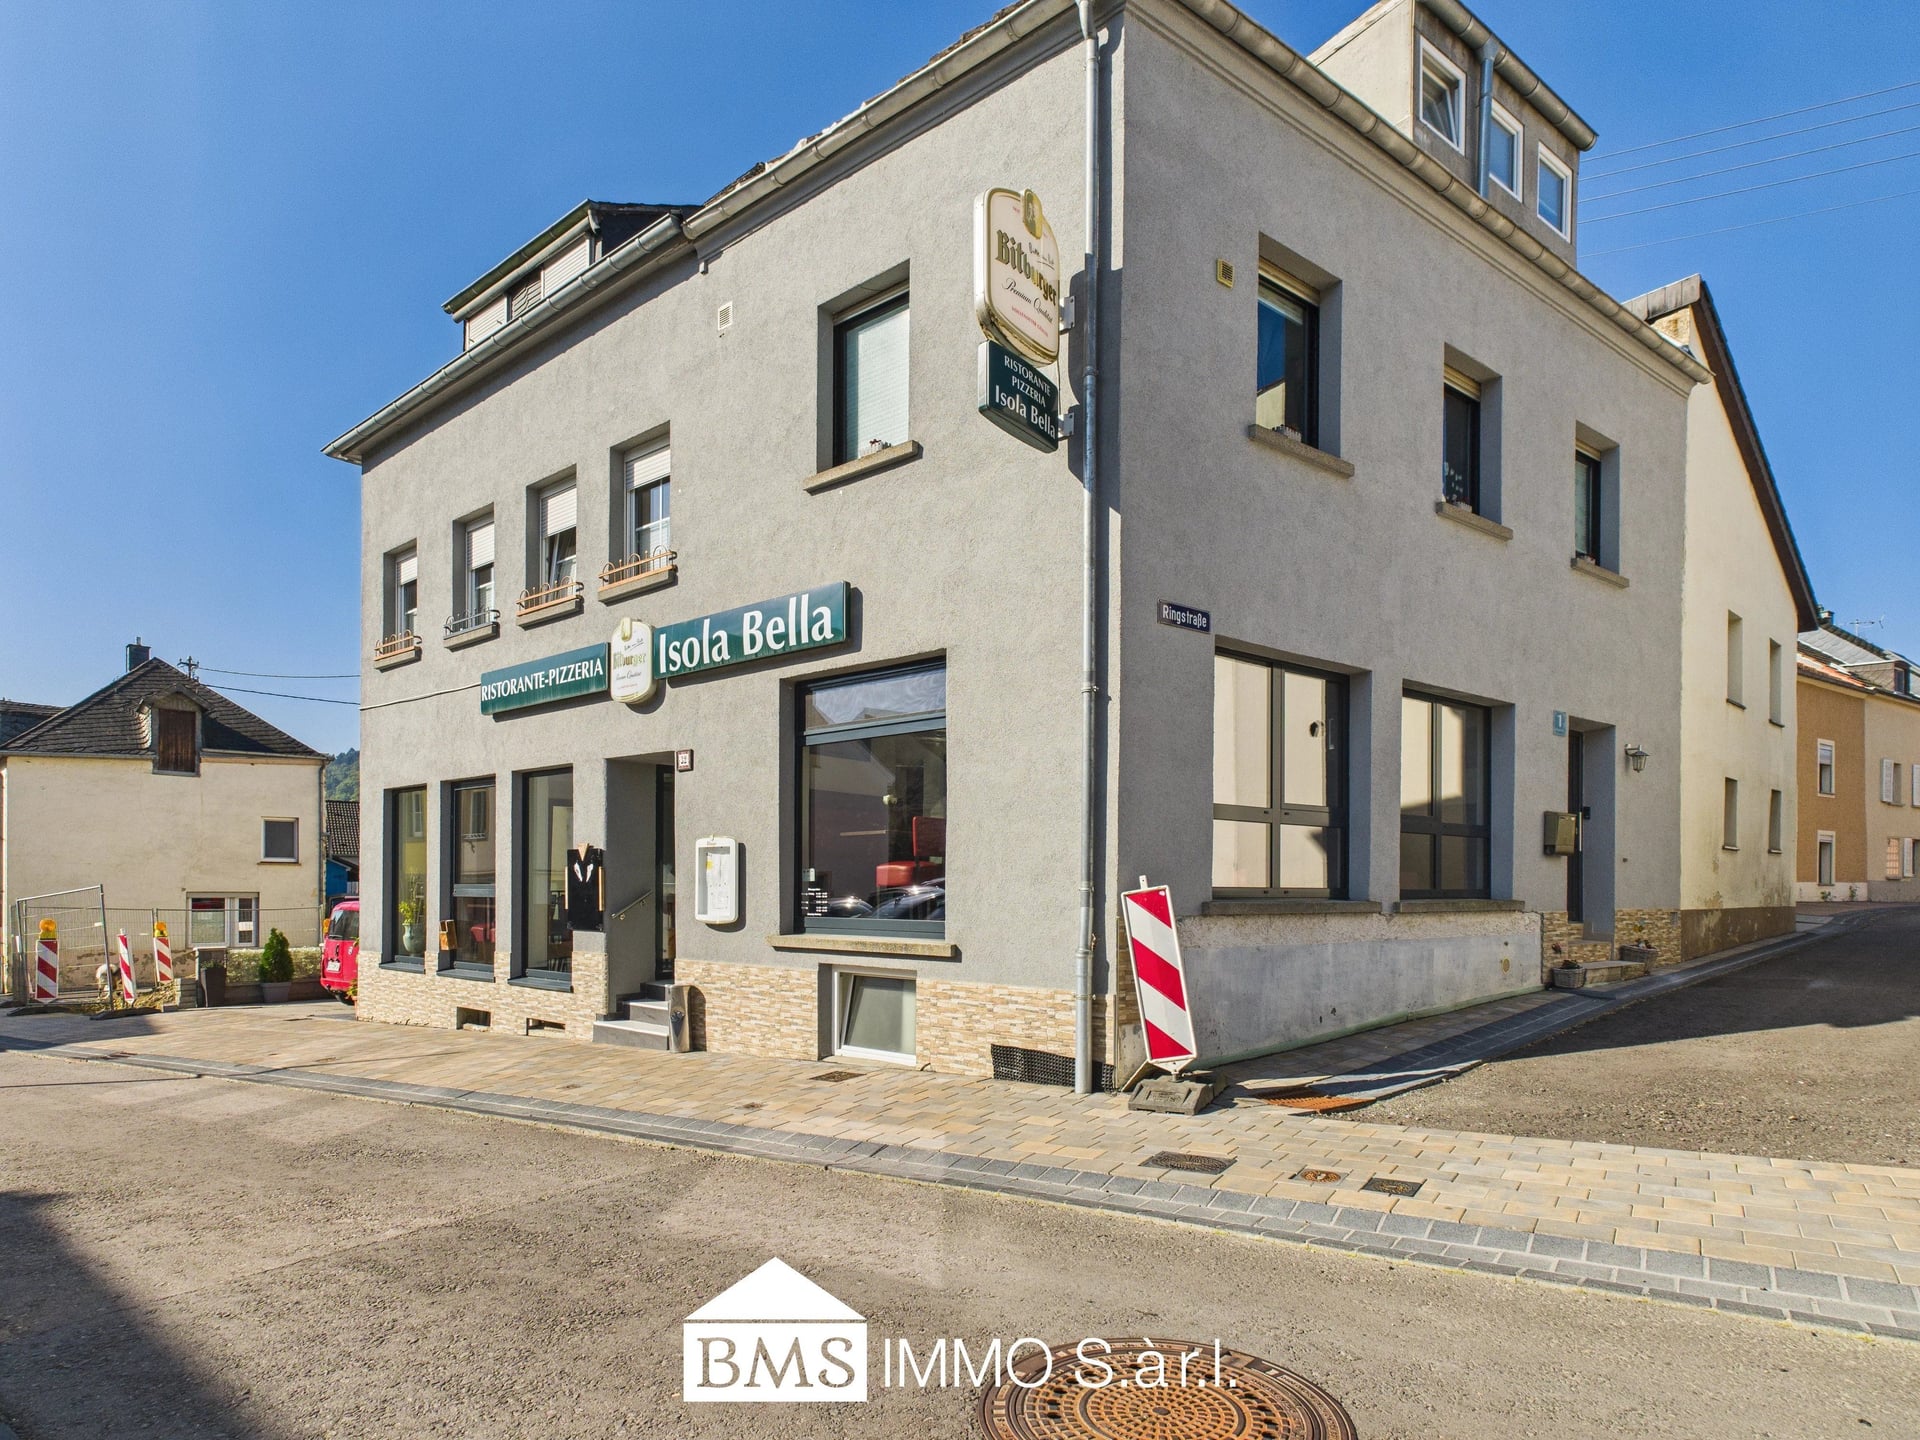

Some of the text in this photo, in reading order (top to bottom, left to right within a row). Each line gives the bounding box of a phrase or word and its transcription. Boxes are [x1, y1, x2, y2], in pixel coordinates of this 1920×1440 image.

[994, 229, 1057, 306] Bitburger
[1001, 277, 1032, 304] Premium
[1004, 354, 1051, 397] RISTORANTE
[1011, 375, 1046, 408] PIZZERIA
[995, 384, 1056, 440] Isola Bella
[659, 593, 834, 674] Isola Bella
[1162, 604, 1207, 629] Ringstraße
[481, 658, 604, 702] RISTORANTE-PIZZERIA
